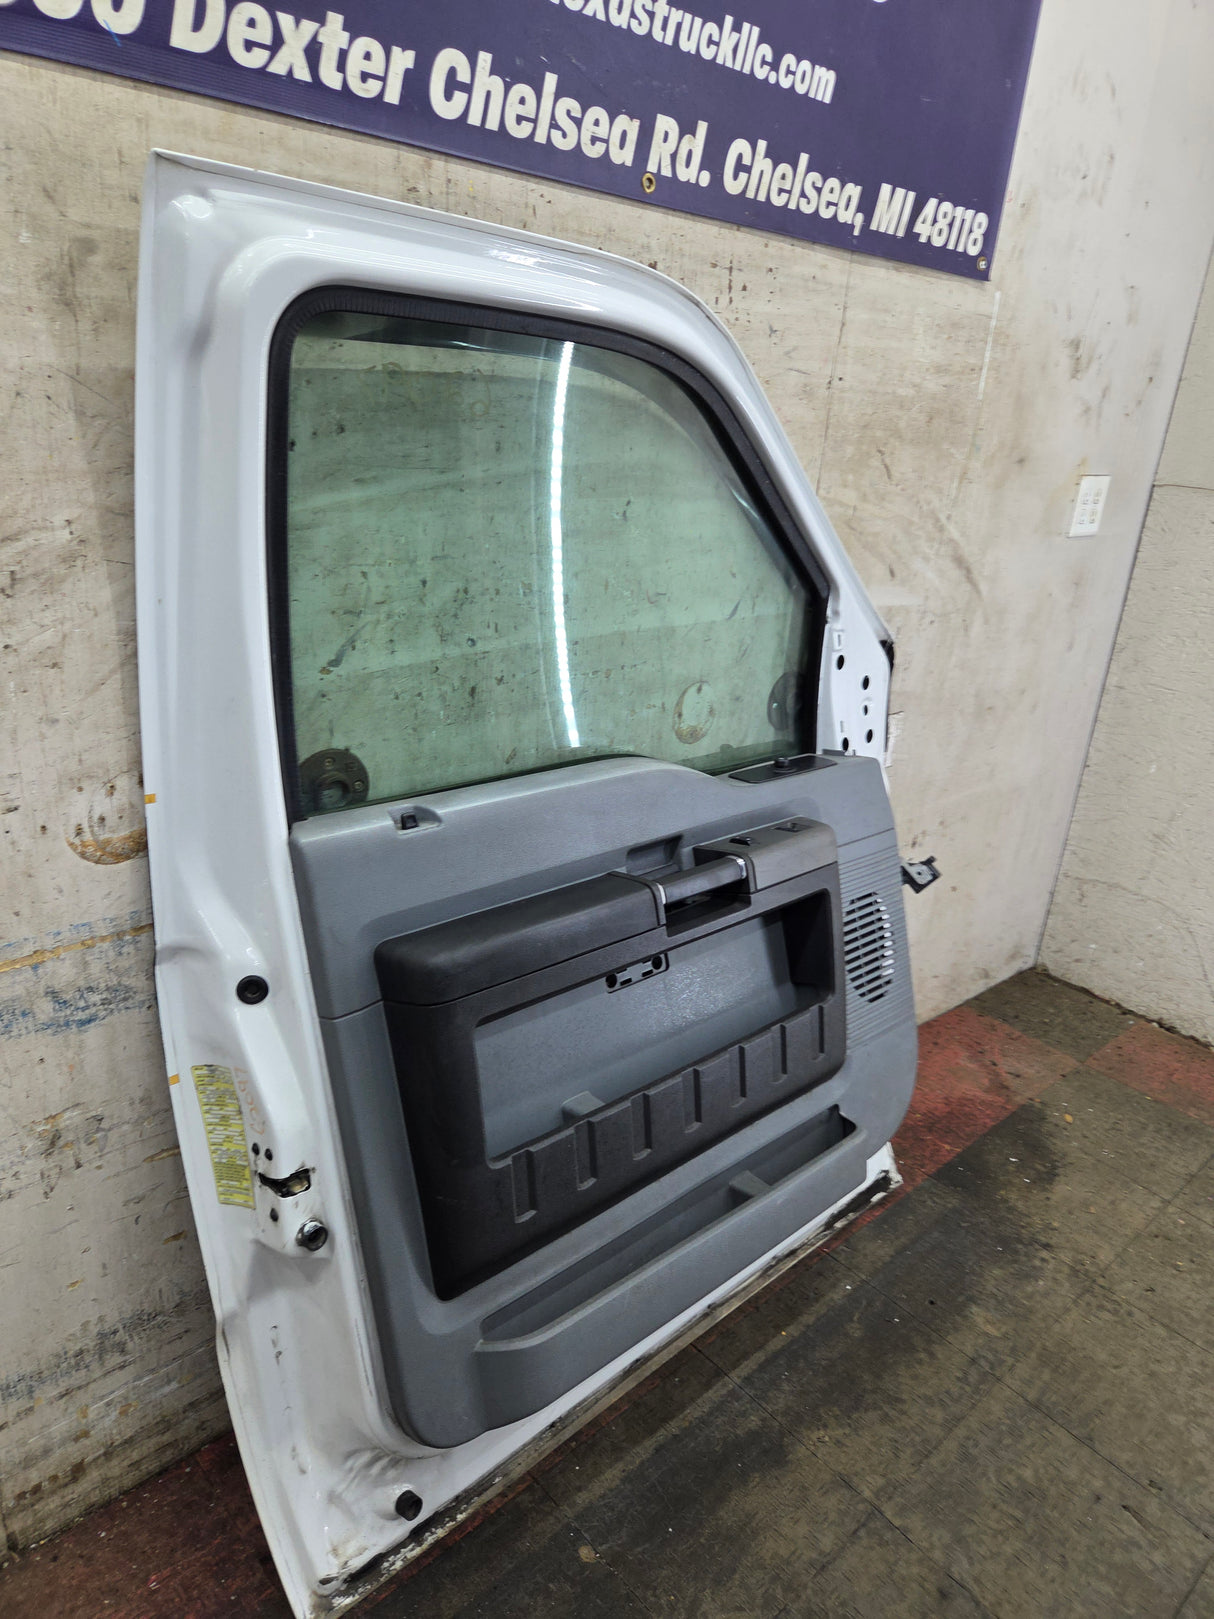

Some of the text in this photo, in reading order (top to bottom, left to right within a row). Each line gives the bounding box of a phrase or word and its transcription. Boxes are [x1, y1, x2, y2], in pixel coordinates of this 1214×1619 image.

[168, 0, 416, 105] Dexter
[429, 47, 641, 167] Chelsea
[645, 113, 711, 188] Rd.
[723, 138, 864, 237] Chelsea,
[869, 183, 917, 238] MI
[912, 197, 989, 257] 48118
